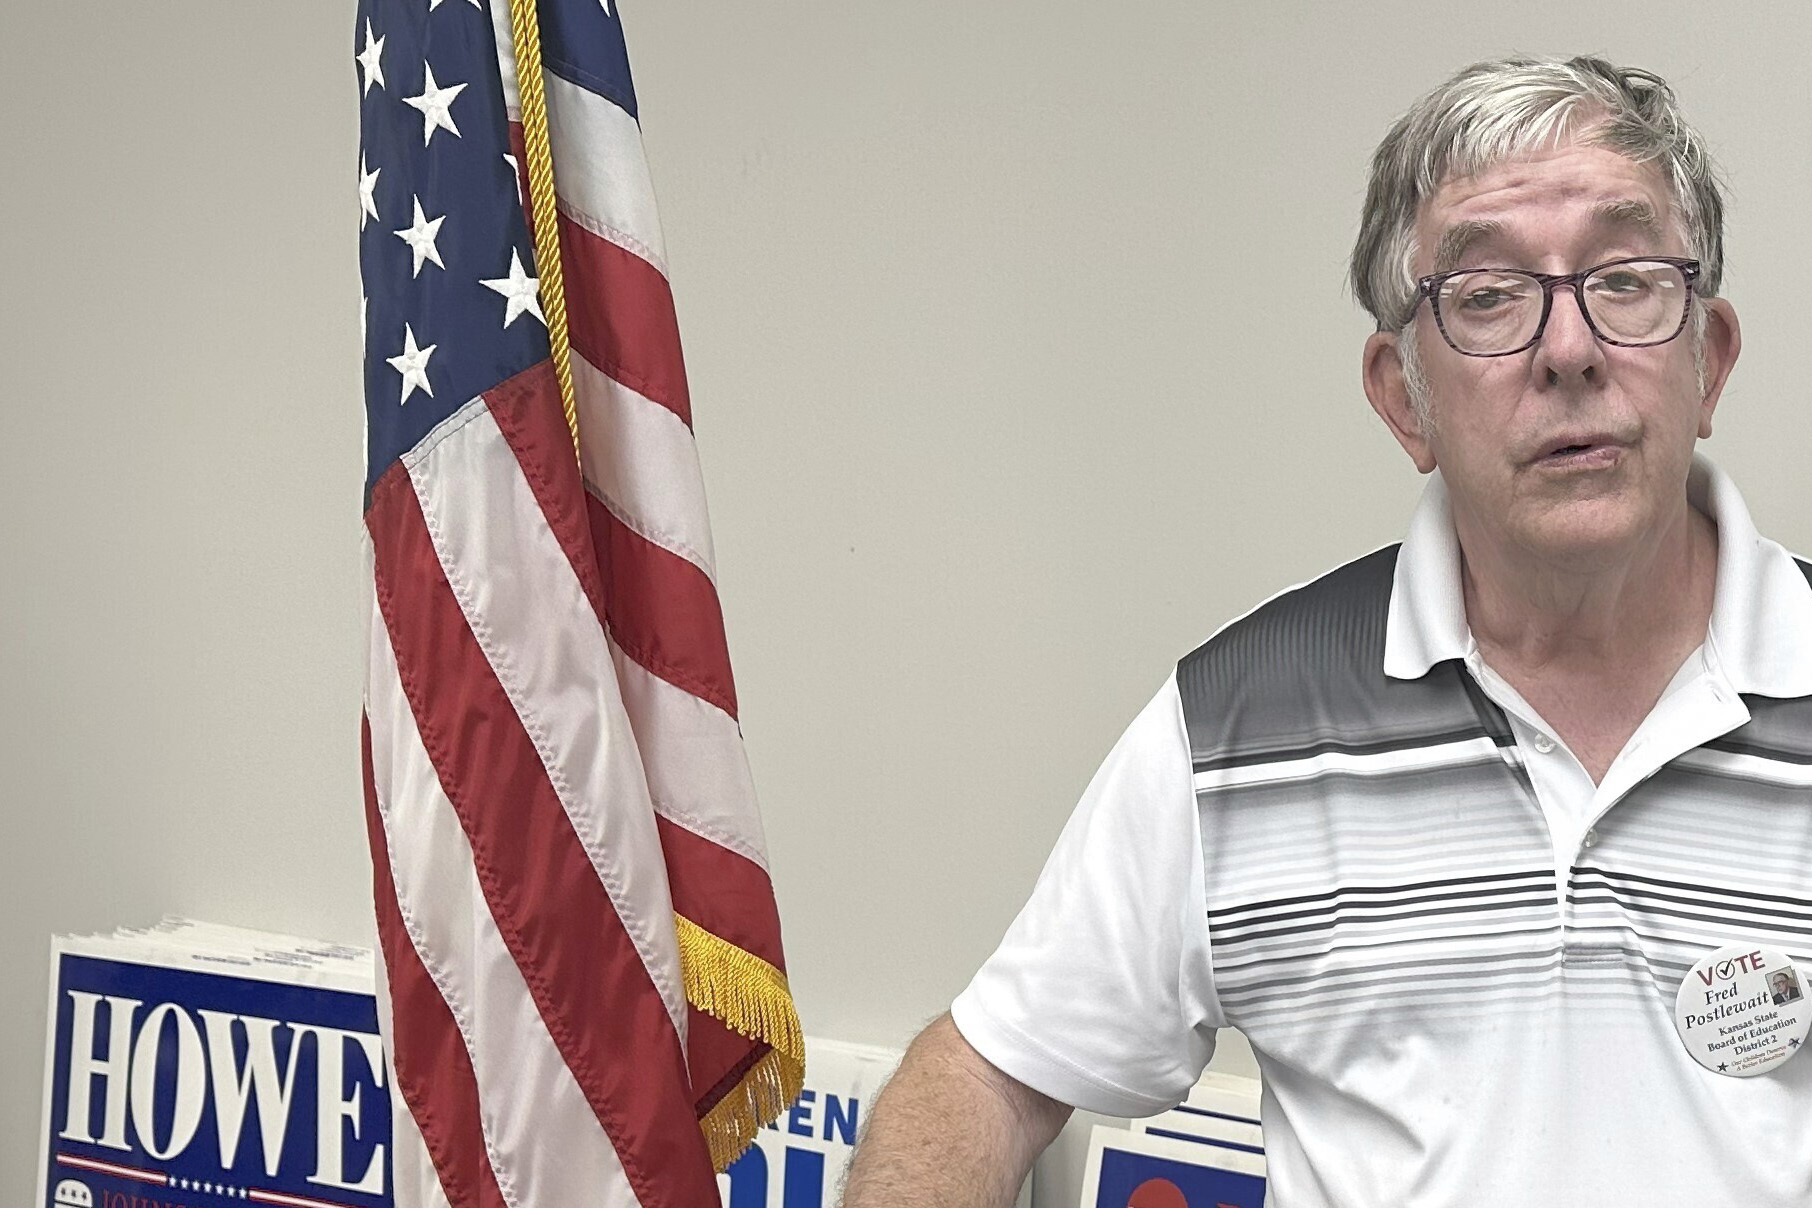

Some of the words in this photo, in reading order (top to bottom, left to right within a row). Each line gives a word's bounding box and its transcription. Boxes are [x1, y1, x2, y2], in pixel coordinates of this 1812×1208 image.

[1697, 950, 1766, 986] VOTE
[1685, 991, 1769, 1029] Postlewait
[1705, 982, 1738, 1005] Fred
[1707, 1036, 1737, 1052] Board
[1737, 1030, 1749, 1042] of
[1749, 1016, 1797, 1039] Education
[1718, 1020, 1754, 1036] Kansas
[1754, 1010, 1779, 1025] State
[1734, 1038, 1770, 1055] District
[1769, 1034, 1778, 1044] 2
[58, 989, 386, 1195] HOWE
[766, 1089, 859, 1146] EN
